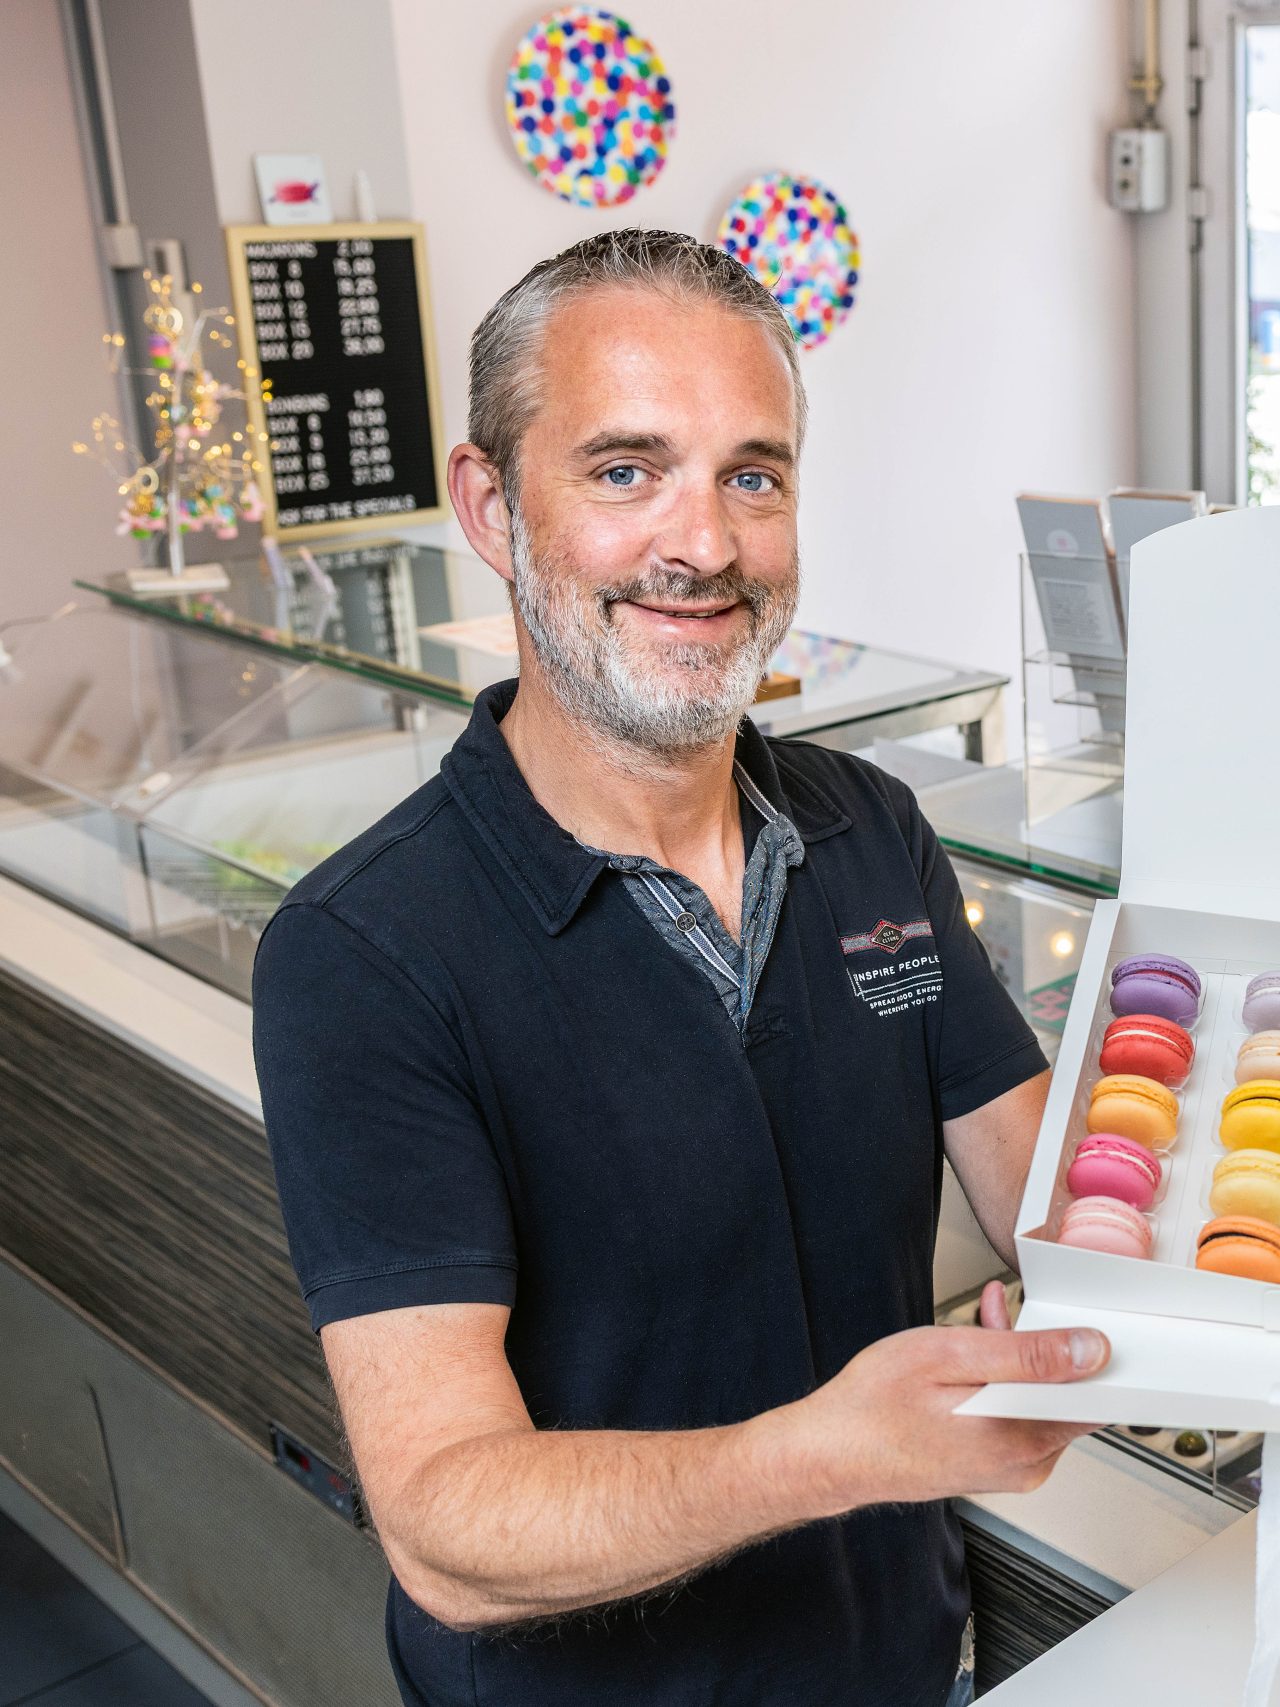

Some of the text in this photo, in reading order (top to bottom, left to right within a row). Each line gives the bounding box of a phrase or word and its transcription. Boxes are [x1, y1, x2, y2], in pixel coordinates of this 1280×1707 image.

[250, 261, 279, 280] BOX
[252, 281, 281, 300] BOX
[284, 280, 304, 299] 10
[255, 301, 284, 320] BOX
[288, 300, 307, 319] 12
[257, 322, 287, 341] BOX
[290, 320, 311, 339] 15
[259, 341, 289, 361] BOX
[292, 340, 314, 360] 20
[269, 416, 299, 435] BOX
[271, 436, 301, 454] BOX
[273, 455, 303, 474] BOX
[275, 474, 306, 494] BOX
[308, 471, 330, 491] 25
[301, 504, 327, 522] FOR
[328, 501, 352, 519] THE
[353, 494, 416, 517] SPECIALS
[853, 955, 940, 982] INSPIRE PEOPLE
[869, 997, 896, 1009] SPREAD
[916, 985, 943, 996] ENERG
[927, 995, 938, 1003] GO
